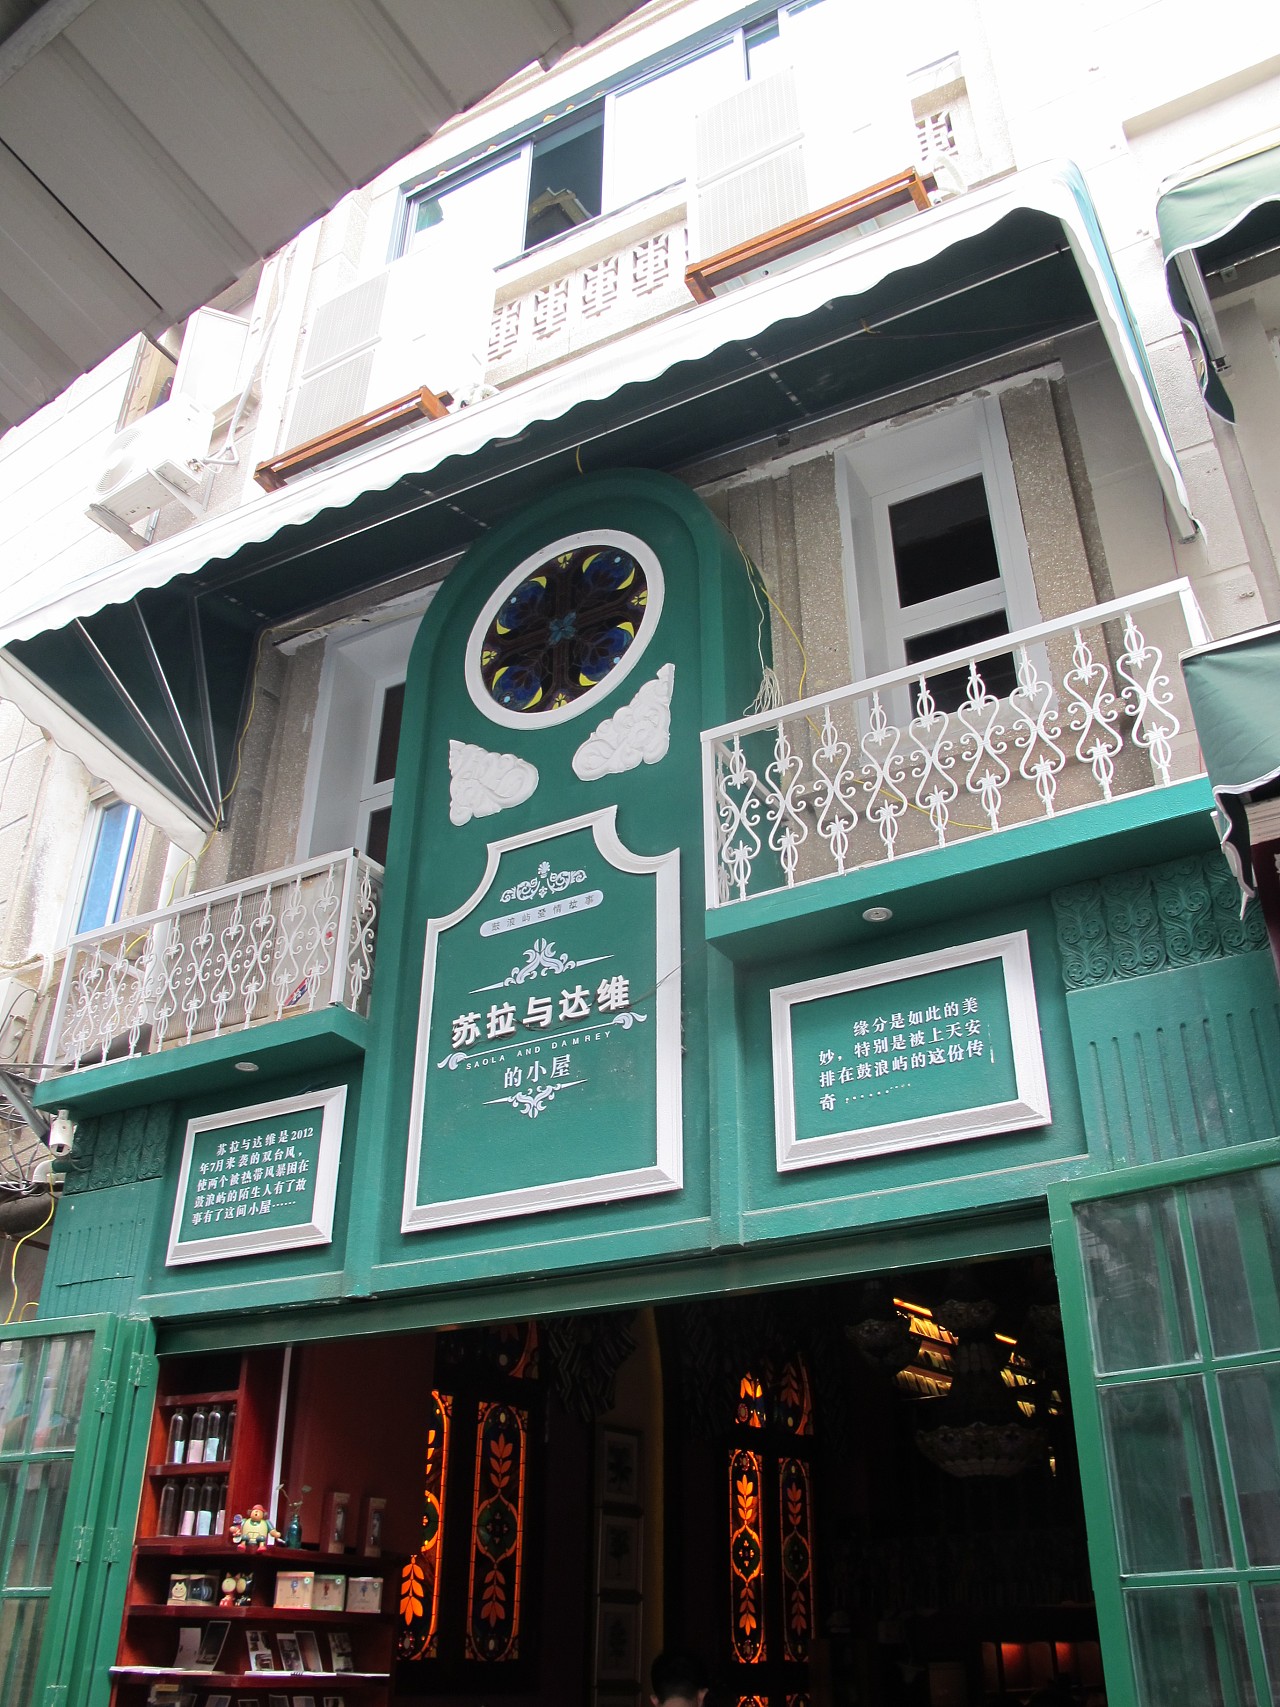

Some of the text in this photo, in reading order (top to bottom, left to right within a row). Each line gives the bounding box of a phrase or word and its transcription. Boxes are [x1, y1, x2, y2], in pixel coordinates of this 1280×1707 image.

[452, 975, 630, 1049] 苏拉与达维
[853, 997, 979, 1037] 缘分是如此的美
[466, 1031, 611, 1070] SAOLA AND DAMREY
[818, 1018, 982, 1066] 妙，特别是被上天安
[504, 1053, 571, 1088] 的小屋
[818, 1039, 985, 1087] 排在鼓浪屿的这份传
[216, 1127, 314, 1156] 苏拉与达维是2012
[194, 1178, 307, 1209] 鼓浪屿的陌生人有了故
[197, 1159, 310, 1192] 使两个被热带风暴困在
